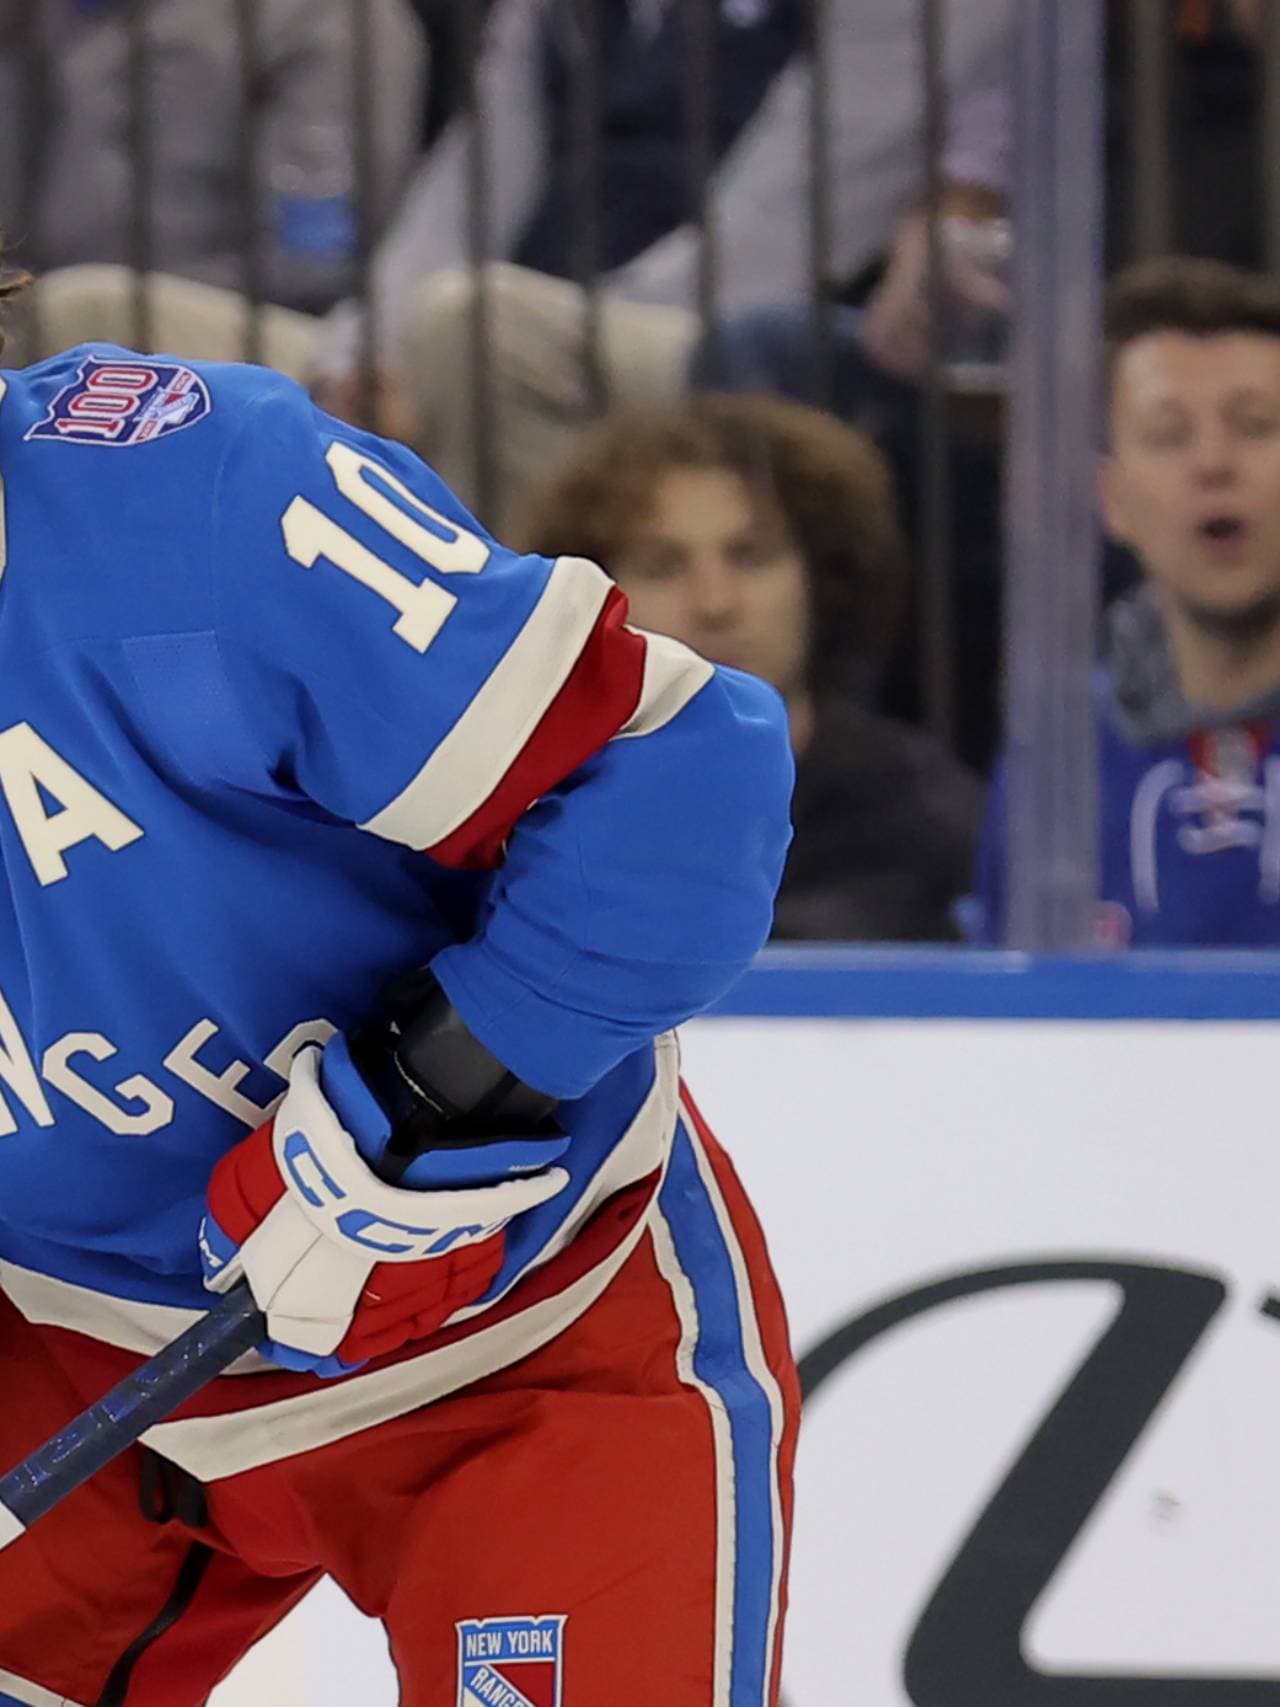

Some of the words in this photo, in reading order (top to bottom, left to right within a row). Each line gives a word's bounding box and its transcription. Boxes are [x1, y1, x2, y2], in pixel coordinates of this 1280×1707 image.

[54, 366, 159, 439] 100
[280, 441, 491, 655] 10
[466, 1631, 502, 1658] NEW
[507, 1629, 553, 1654] YORK
[470, 1667, 526, 1707] RANG
